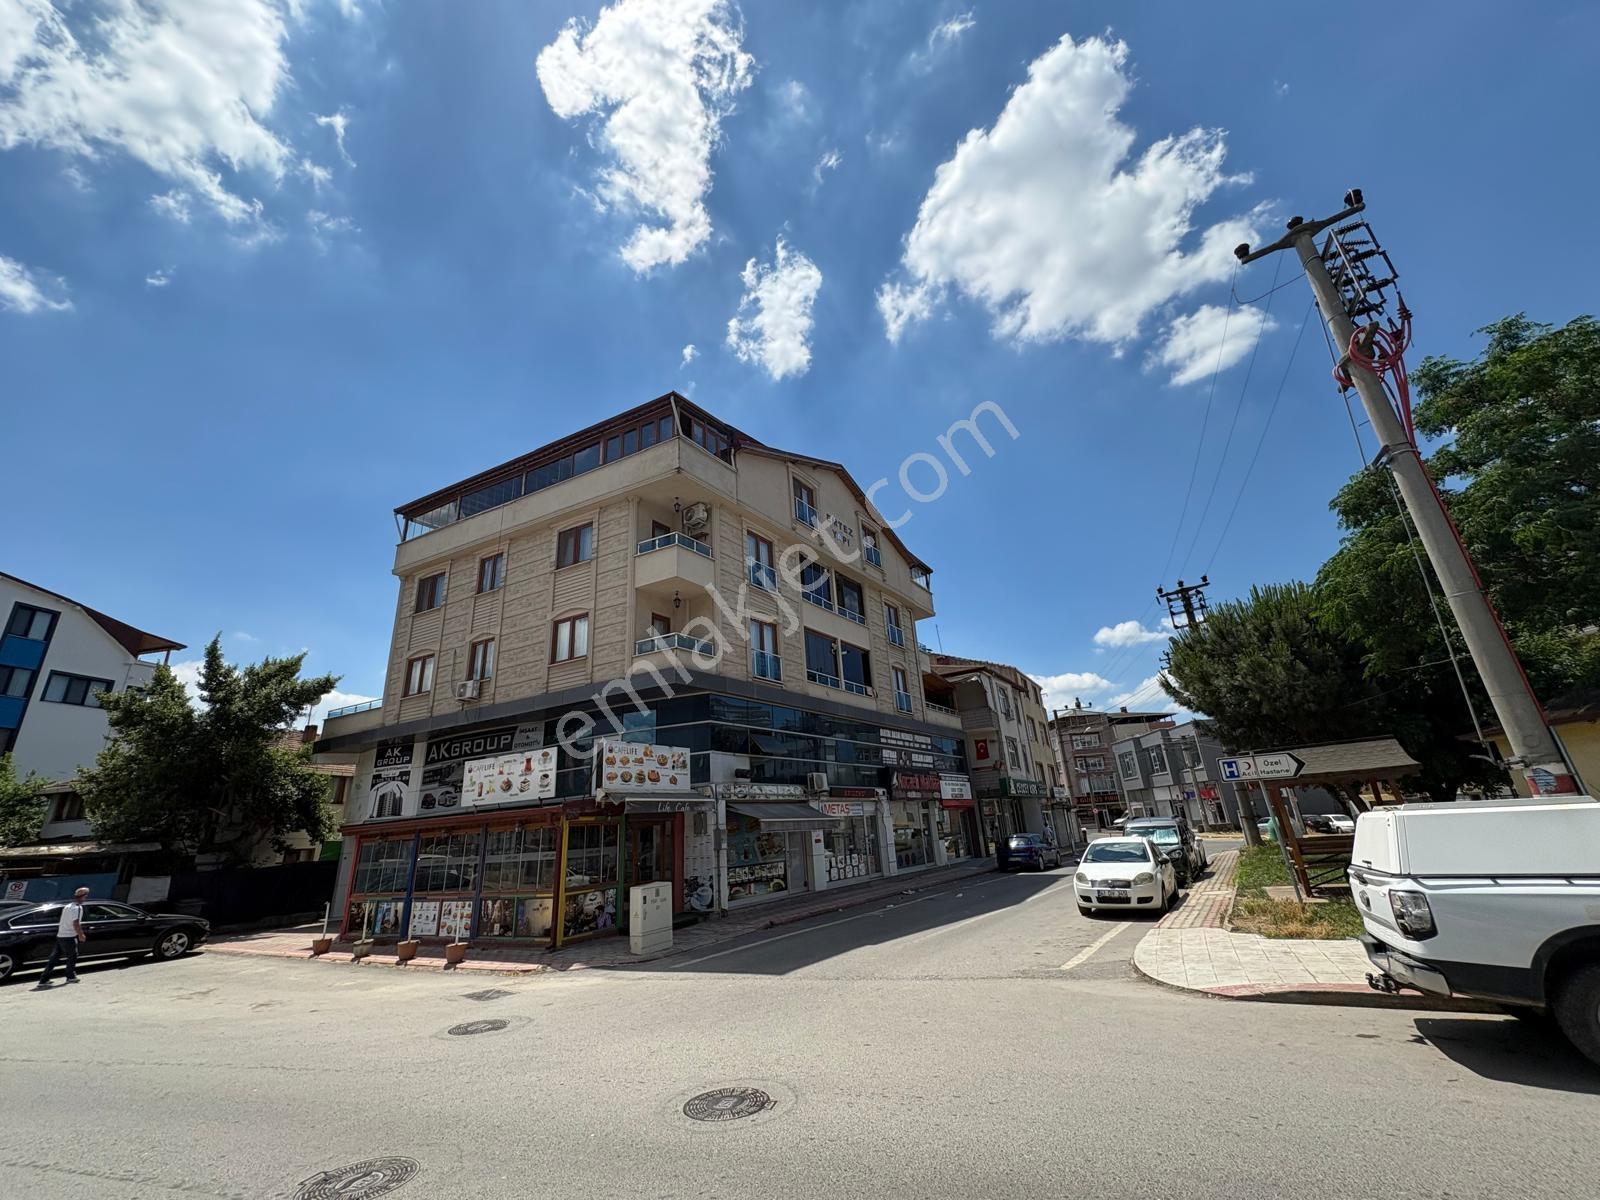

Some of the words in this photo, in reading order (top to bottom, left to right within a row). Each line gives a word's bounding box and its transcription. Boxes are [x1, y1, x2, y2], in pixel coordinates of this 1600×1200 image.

[385, 746, 401, 758] AK
[427, 734, 513, 761] AKGROUP
[376, 756, 410, 767] GROUP
